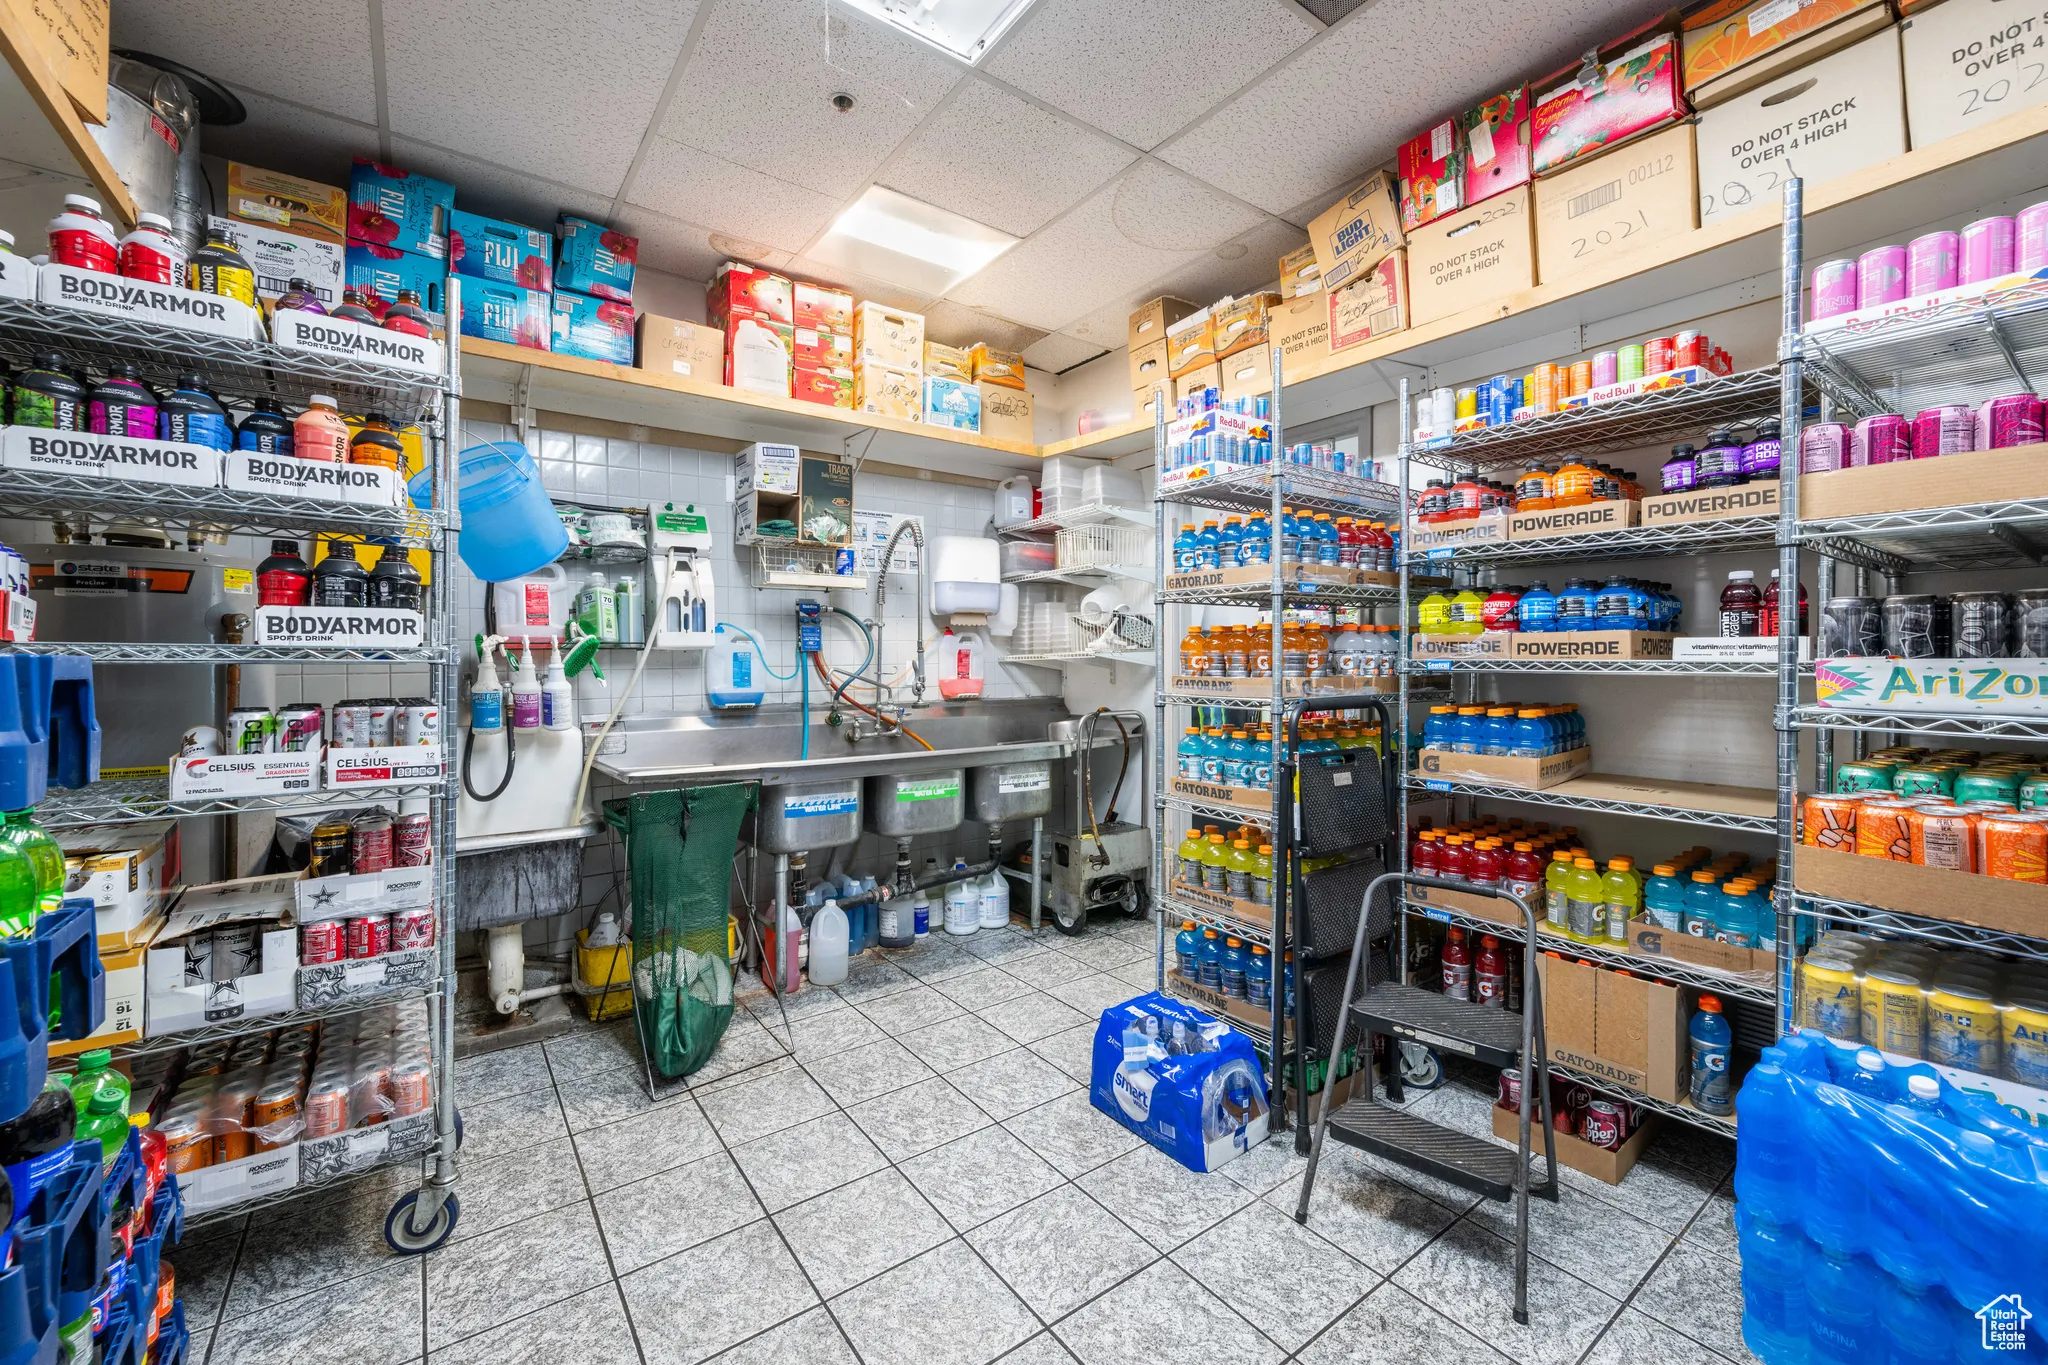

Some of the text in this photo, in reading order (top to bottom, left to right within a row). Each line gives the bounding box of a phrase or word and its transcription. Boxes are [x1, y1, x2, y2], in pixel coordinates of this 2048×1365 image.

[1952, 16, 2036, 64] DO NOT
[1964, 35, 2045, 77] OVER 4
[1535, 91, 1578, 119] California
[1732, 96, 1857, 157] DO NOT STACK
[1740, 119, 1848, 170] OVER 4 HIGH
[1628, 154, 1675, 186] 00112
[380, 188, 405, 220] FIJI
[1335, 224, 1370, 256] LIGHT
[1337, 218, 1363, 243] BUD
[257, 239, 294, 253] ProPak
[315, 242, 333, 251] 22463
[484, 240, 519, 271] FIJI
[594, 248, 615, 276] FIJI
[1430, 239, 1505, 275] DO NOT STACK
[1435, 255, 1500, 286] OVER 4 HIGH
[60, 274, 226, 321] BODYARMOR
[61, 293, 135, 312] SPORTS DRINK
[1814, 295, 1855, 308] PINK
[483, 301, 518, 329] FIJI
[295, 322, 424, 364] BODYARMOR
[1281, 328, 1306, 346] DO NOT
[1286, 334, 1328, 355] OVER 4 HIGH
[296, 339, 355, 355] SPORTS DRINK
[1593, 385, 1635, 401] Red Bull
[1219, 416, 1246, 430] Red Bull
[28, 436, 198, 470] BODYARMOR
[30, 456, 105, 468] SPORTS DRINK
[248, 458, 380, 488] BODYARMOR
[828, 463, 850, 476] TRACK
[1163, 471, 1184, 483] Red Bull
[248, 475, 307, 488] SPORTS DRINK
[1648, 488, 1777, 519] POWERADE
[1513, 508, 1614, 532] POWERADE
[1413, 524, 1498, 546] POWERADE
[78, 563, 121, 574] state
[1169, 573, 1224, 589] GATORADE
[603, 596, 612, 604] 70
[266, 616, 417, 635] BODYARMOR
[1517, 641, 1619, 655] POWERADE
[1176, 678, 1233, 692] GATORADE
[209, 762, 256, 773] CELSIUS
[264, 761, 310, 769] ESSENTIALS
[337, 757, 388, 768] CELSIUS
[1540, 760, 1573, 781] GATORADE
[914, 789, 932, 797] WATER
[1174, 781, 1233, 801] GATORADE
[804, 803, 841, 813] WATER LINE
[314, 838, 346, 846] ROCKSTAR
[387, 881, 423, 890] ROCKSTAR
[1175, 885, 1235, 911] GATORADE
[215, 932, 252, 943] ROCKSTAR
[387, 961, 425, 973] ROCKSTAR
[1169, 978, 1228, 1012] GATORADE
[1555, 1050, 1638, 1086] GATORADE
[1115, 1073, 1148, 1108] smart
[1133, 1098, 1149, 1114] water
[1587, 1118, 1601, 1131] Dr
[248, 1157, 290, 1173] ROCKSTAR
[252, 1164, 286, 1175] RECOVERY
